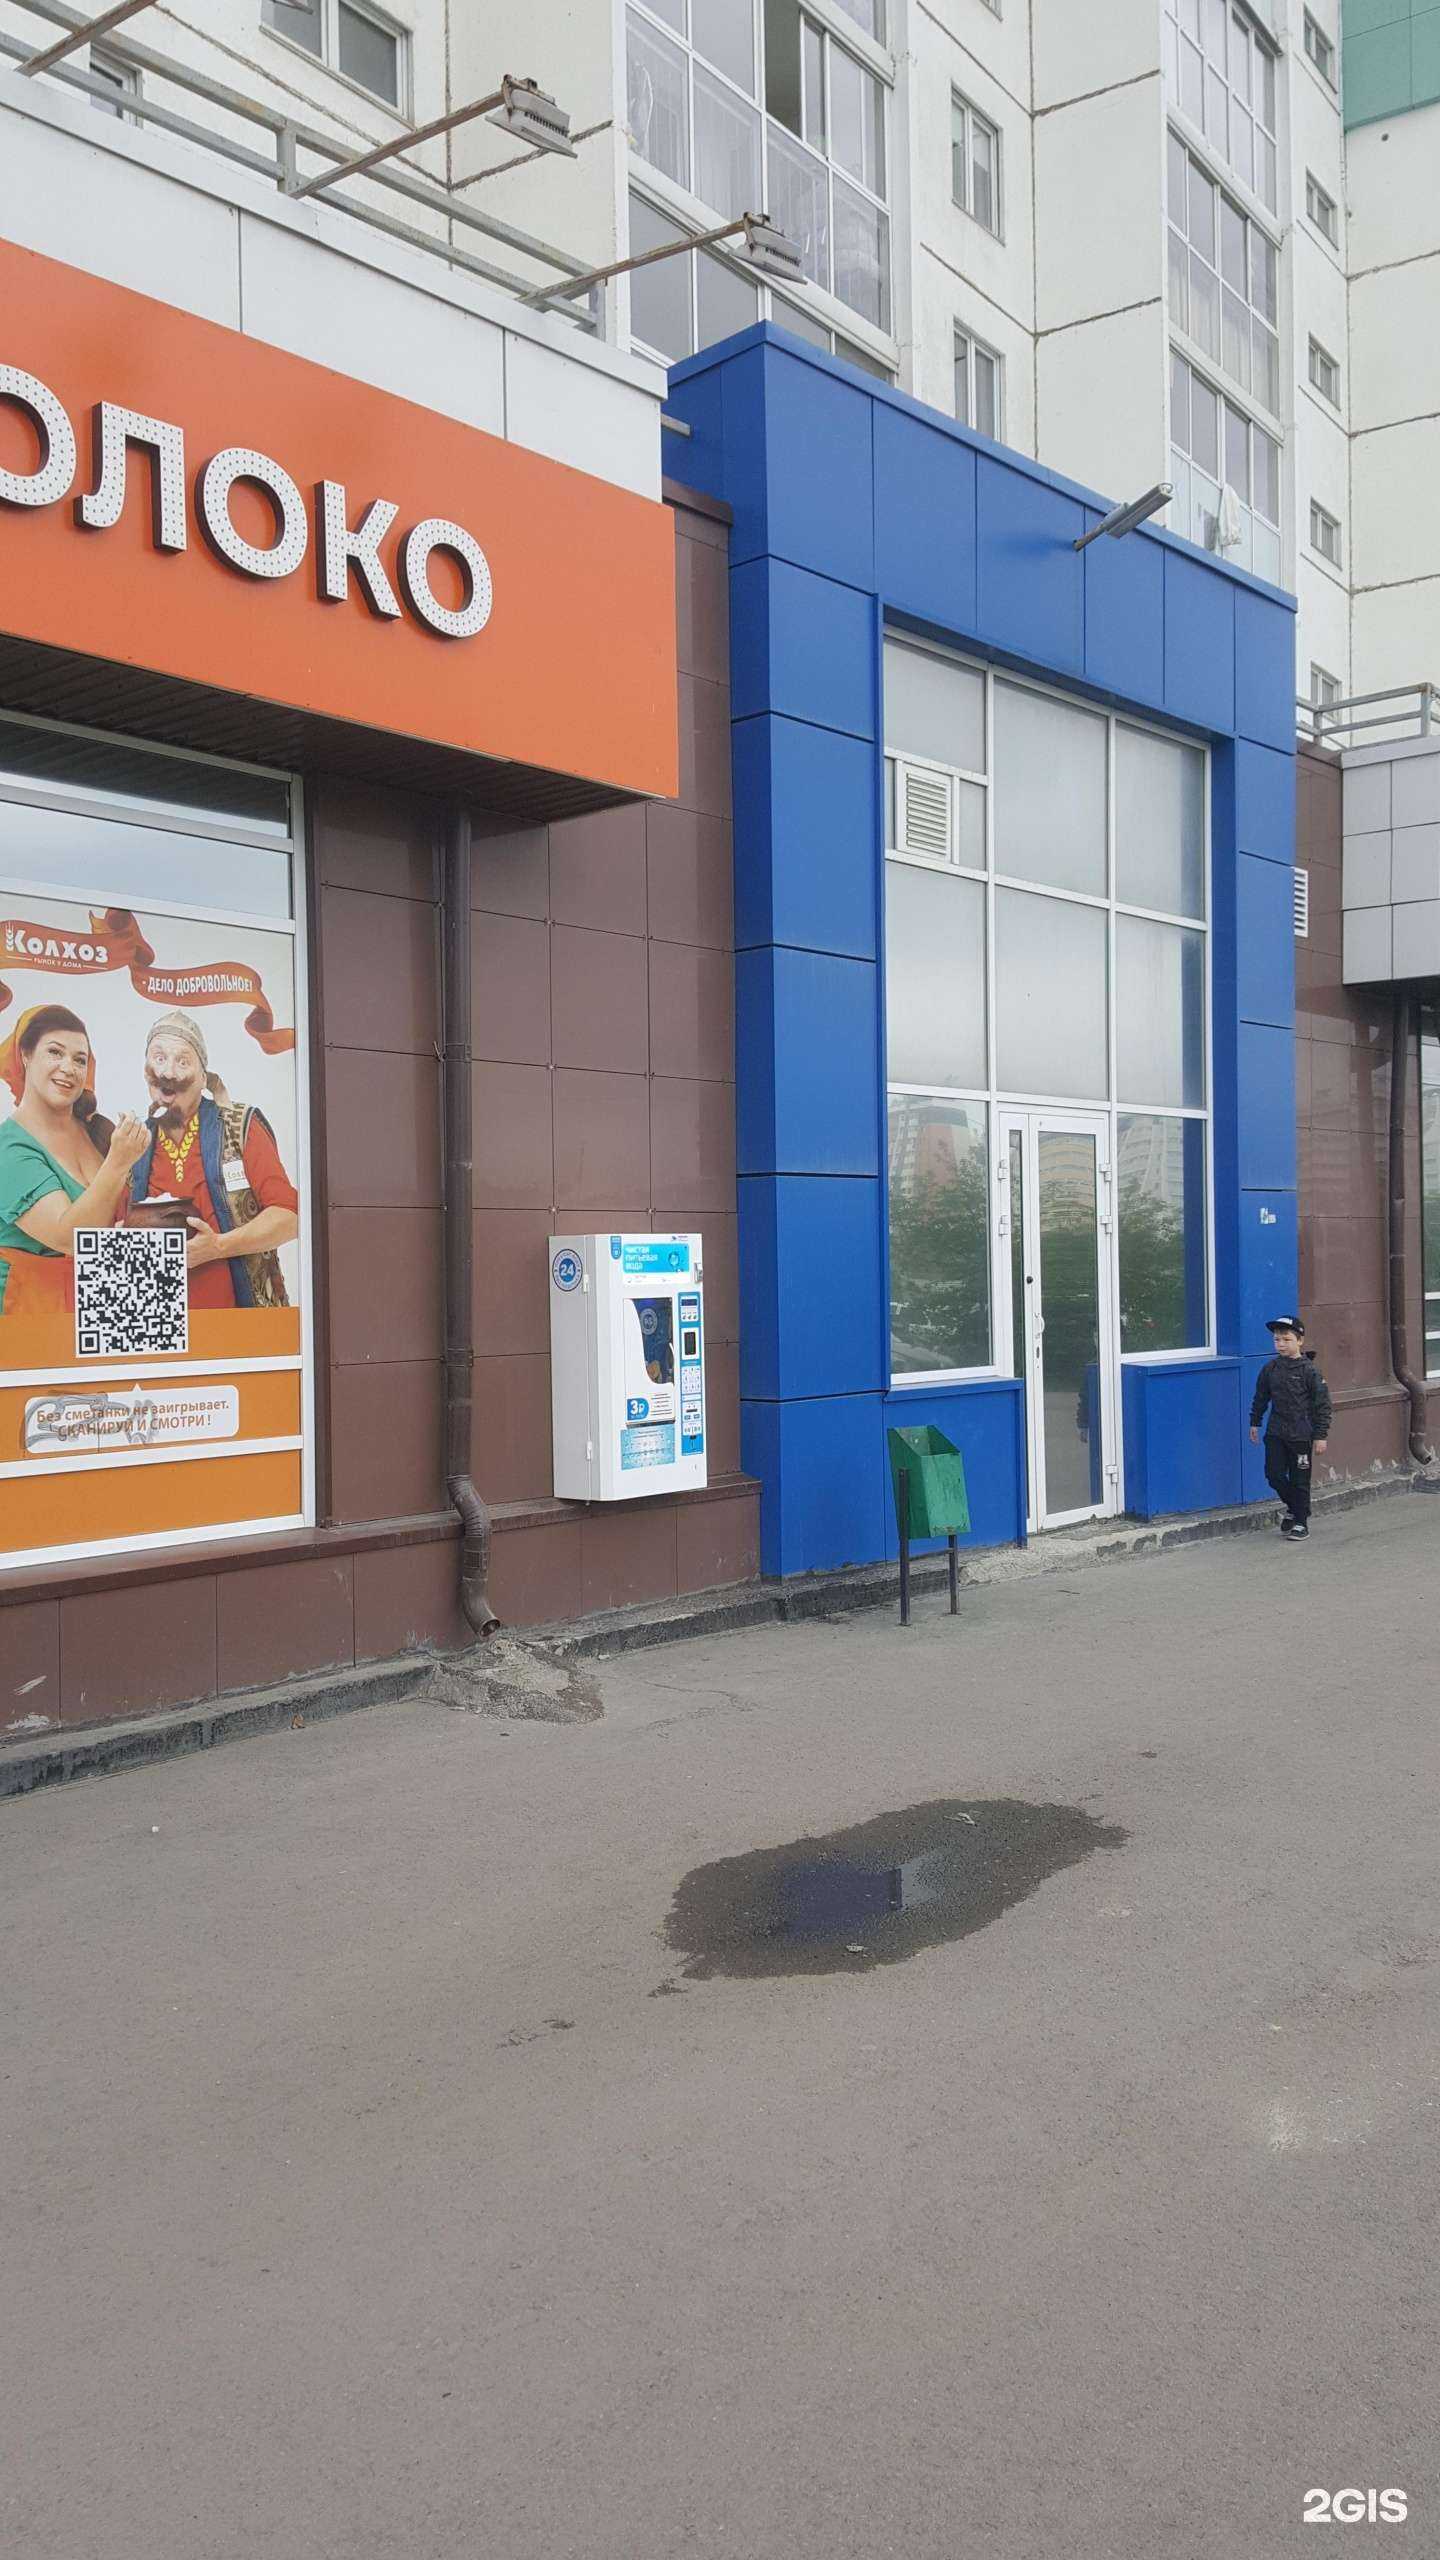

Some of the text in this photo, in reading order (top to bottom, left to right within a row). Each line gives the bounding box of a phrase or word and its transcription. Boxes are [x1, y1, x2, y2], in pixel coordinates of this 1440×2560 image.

[0, 363, 493, 639] ОЛОКО
[148, 976, 174, 994] ДЕЛО
[560, 1263, 574, 1277] 24
[37, 1400, 230, 1424] Без сметанки не заигрывает.
[58, 1418, 134, 1438] СКАНИРУЙ
[137, 1419, 146, 1431] И
